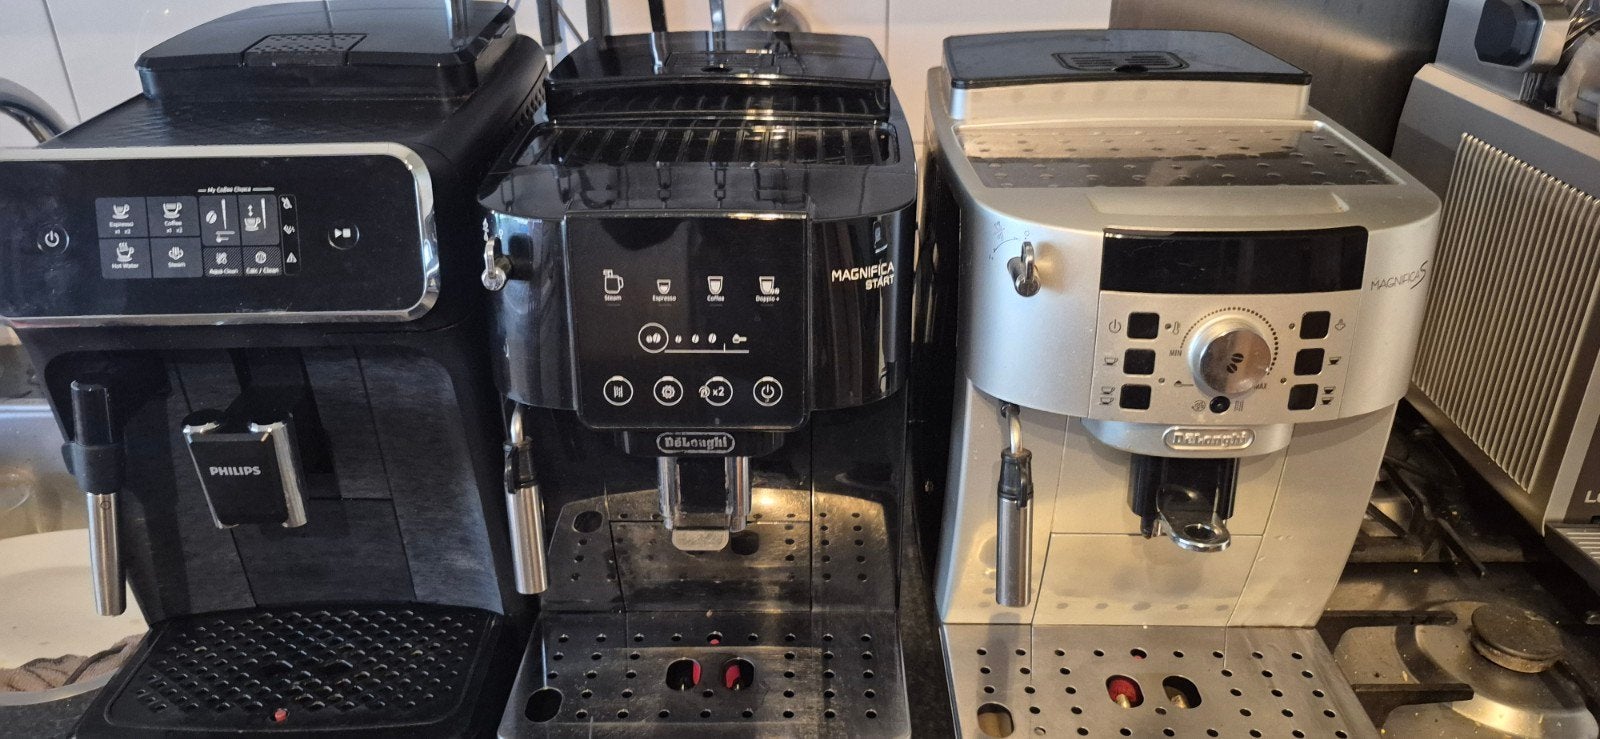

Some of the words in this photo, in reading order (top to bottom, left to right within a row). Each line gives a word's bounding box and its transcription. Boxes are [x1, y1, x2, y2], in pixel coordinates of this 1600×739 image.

[831, 261, 895, 282] MAGNIFICA
[865, 274, 895, 290] START
[604, 294, 622, 302] Steam
[652, 294, 677, 302] Espresso
[707, 294, 725, 302] Coffee
[1169, 349, 1182, 357] MIN
[712, 386, 725, 397] x2
[209, 466, 261, 475] PHILIPS
